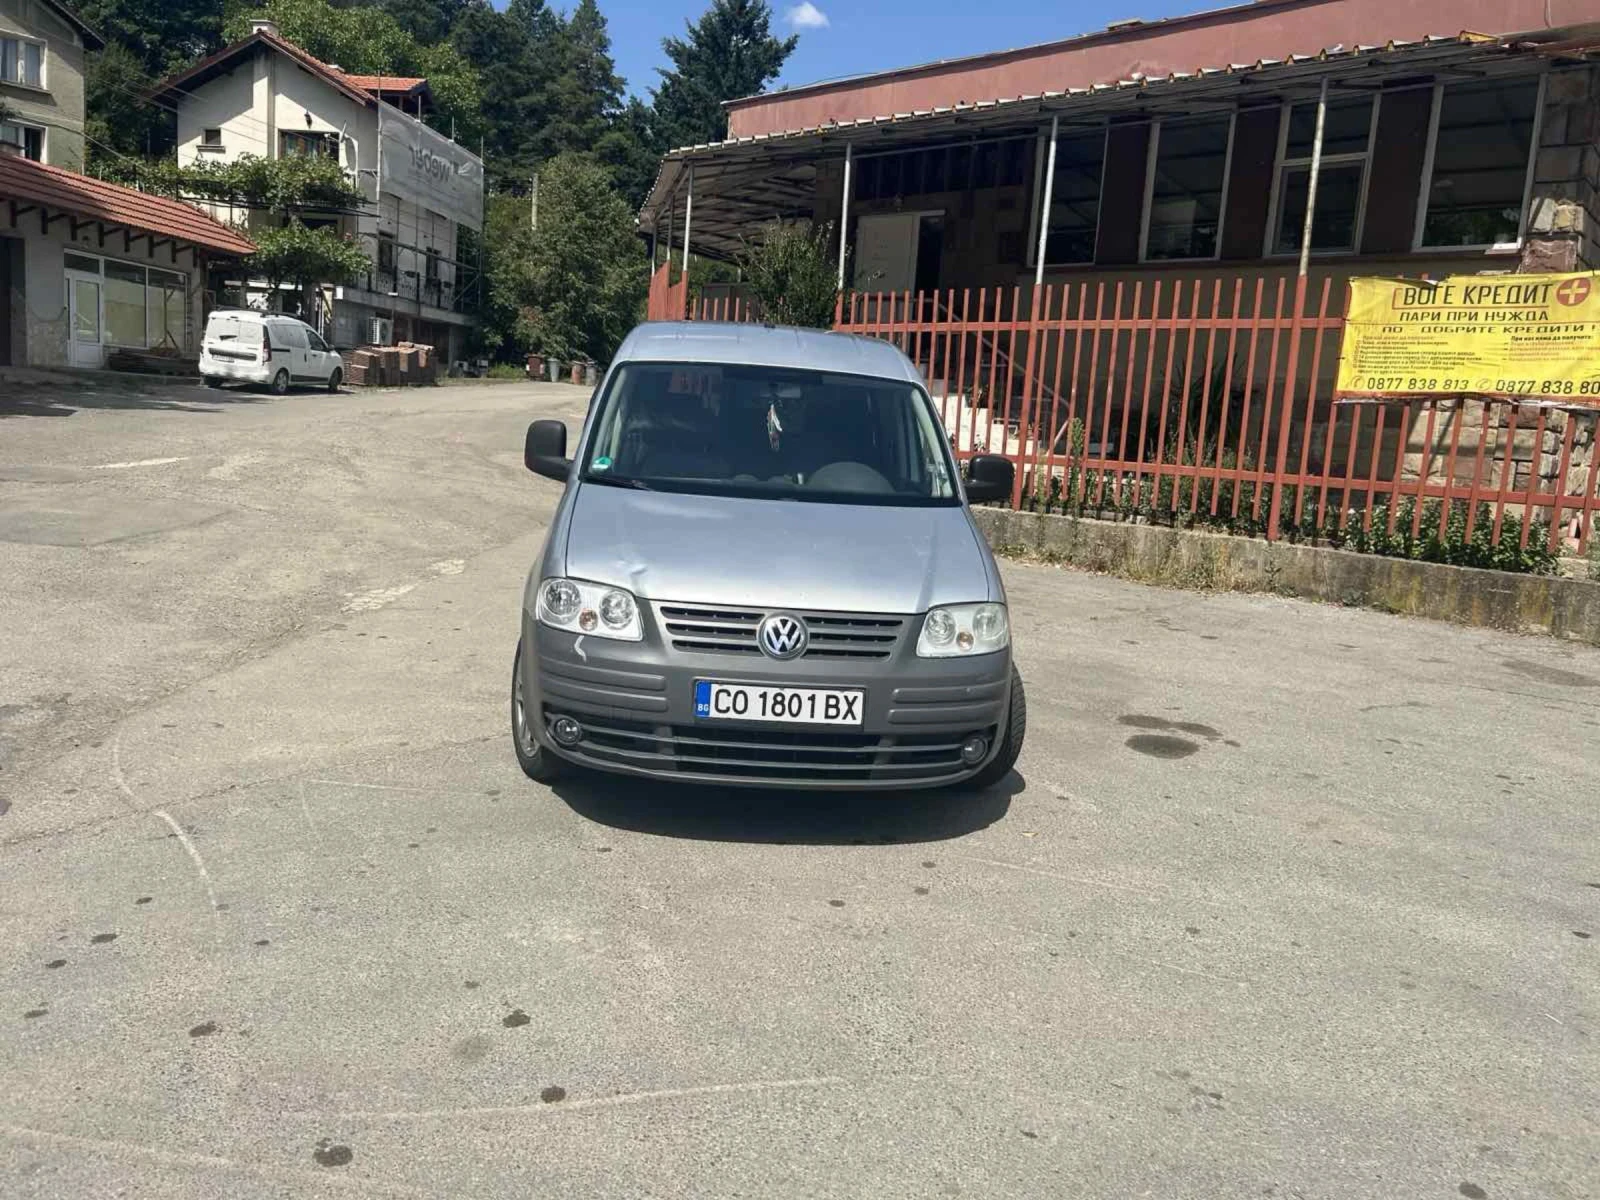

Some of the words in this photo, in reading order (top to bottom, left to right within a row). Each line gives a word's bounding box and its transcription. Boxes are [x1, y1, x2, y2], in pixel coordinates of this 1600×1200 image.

[1463, 284, 1553, 305] КРЕДИТ
[1399, 311, 1441, 321] ПАРИ
[1446, 311, 1479, 321] ПРИ
[1484, 310, 1549, 321] НУЖДА
[1503, 324, 1584, 333] КРЕДИТИ
[1367, 377, 1403, 389] 0877
[1408, 378, 1437, 390] 838
[1443, 379, 1469, 390] 813
[1495, 379, 1536, 393] 0877
[1541, 380, 1573, 394] 838
[697, 703, 709, 712] BG
[714, 689, 748, 715] CO
[758, 691, 816, 719] 1801
[824, 694, 858, 721] BX
